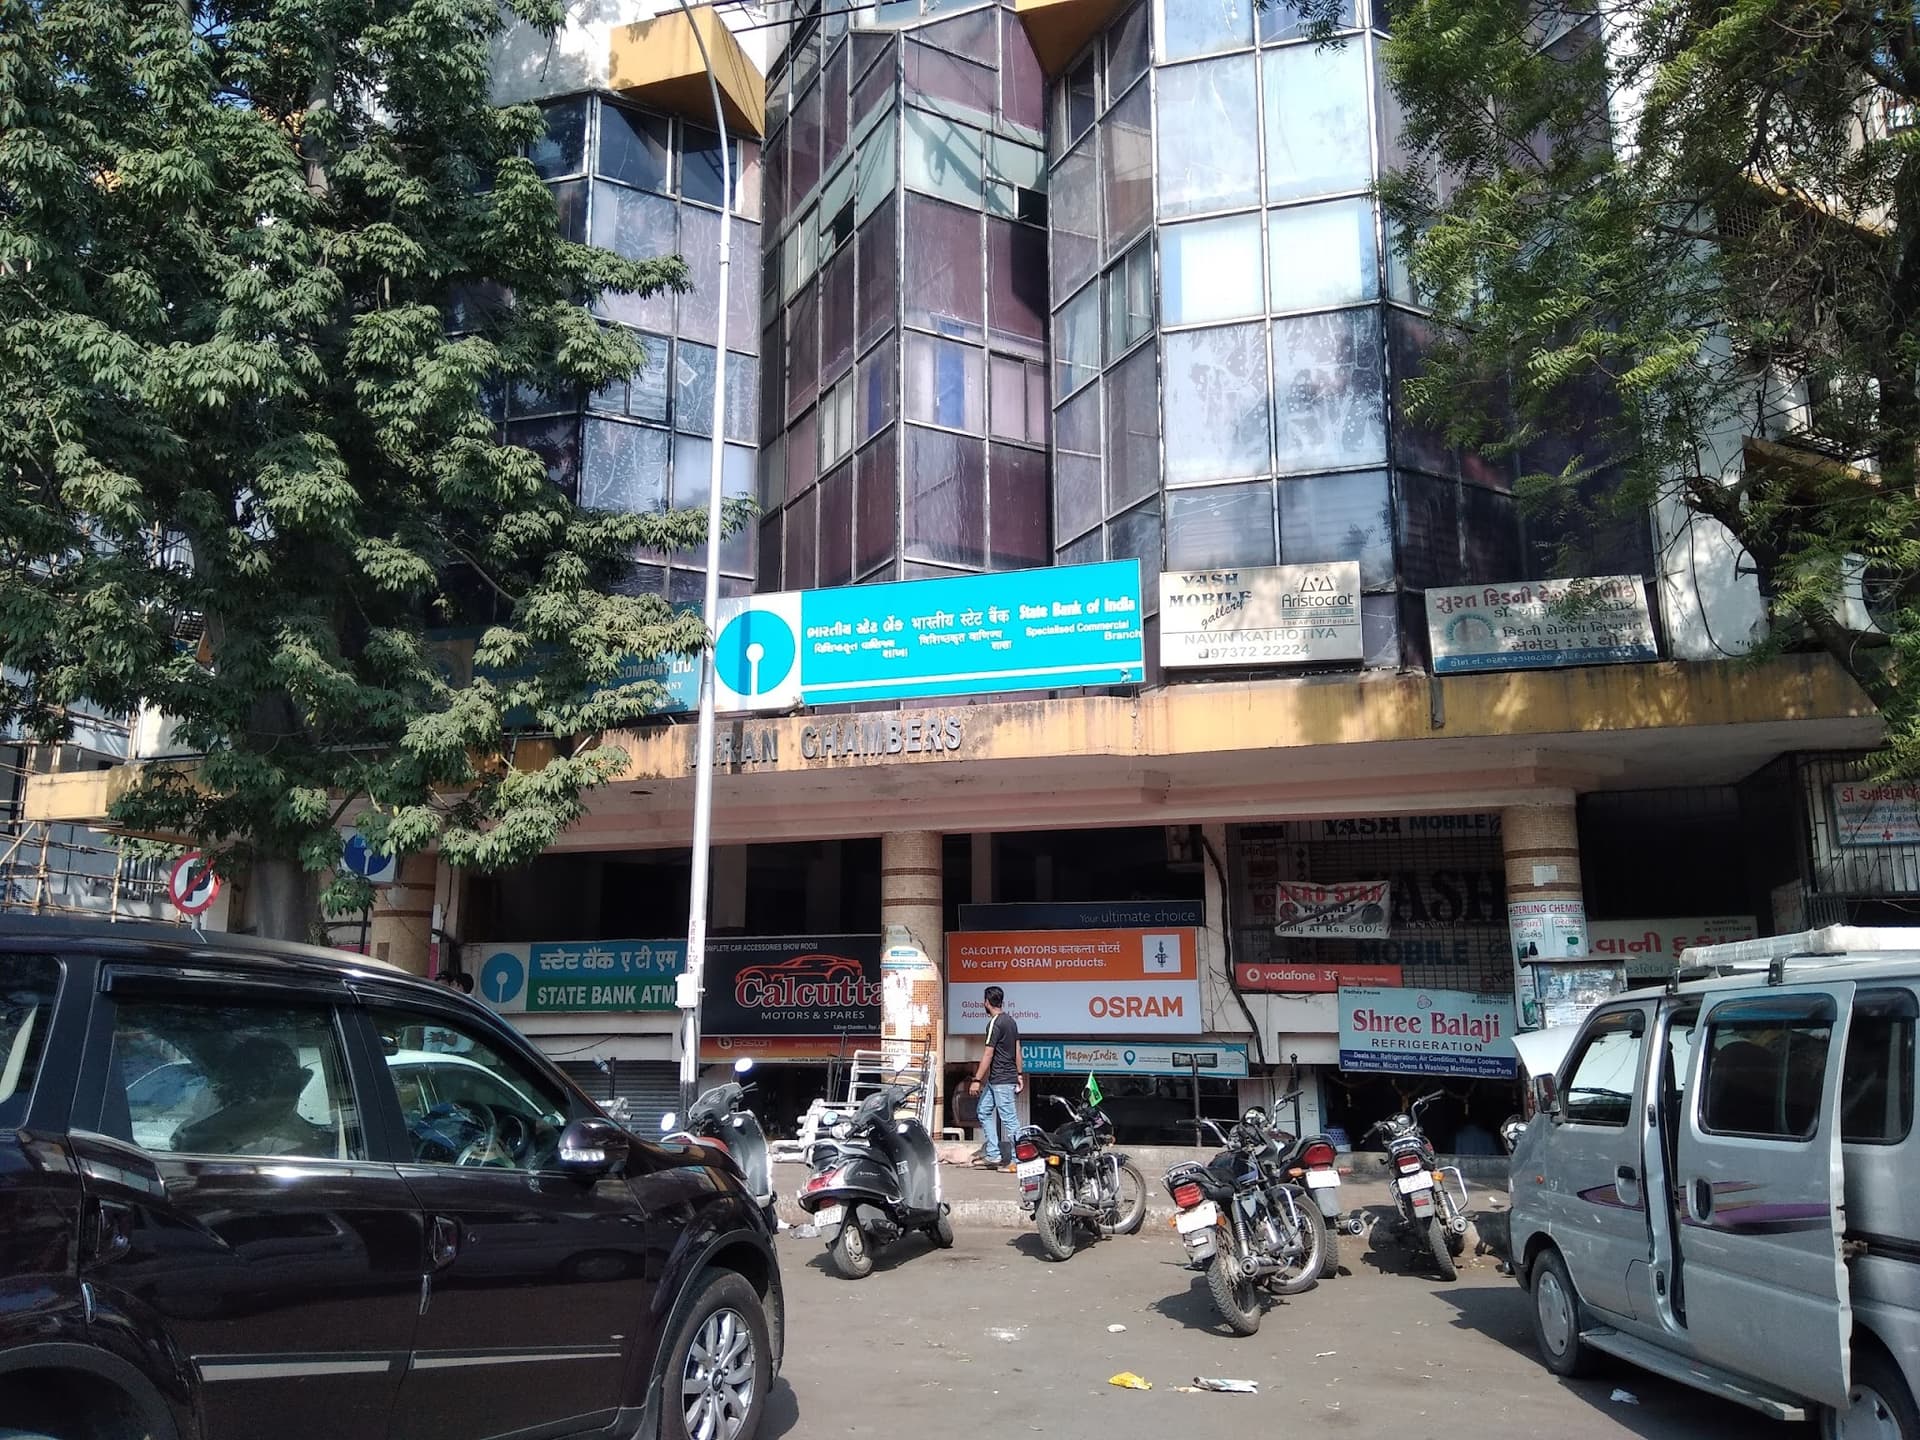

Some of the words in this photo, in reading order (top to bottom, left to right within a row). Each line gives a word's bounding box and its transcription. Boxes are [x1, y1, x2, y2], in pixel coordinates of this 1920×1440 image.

[1168, 590, 1252, 608] MOBILE
[1281, 593, 1354, 608] Aristocrat
[1436, 593, 1477, 614] સુરત
[1484, 586, 1533, 607] કિડની
[1019, 604, 1049, 620] State
[1052, 601, 1083, 617] Bank
[1086, 598, 1100, 614] of
[1104, 596, 1136, 612] India
[1201, 600, 1245, 630] gallery
[911, 609, 955, 631] भारतीय
[960, 606, 983, 627] स्टेट
[988, 604, 1010, 624] बैंक
[1025, 624, 1075, 638] Specialised
[1076, 619, 1130, 633] Commercial
[1103, 629, 1142, 641] Branch
[1185, 631, 1235, 645] NAVIN
[1240, 627, 1337, 642] KATHOTIYA
[1211, 646, 1258, 659] 97372
[1263, 643, 1311, 657] 22224
[672, 659, 695, 674] LTD.
[800, 716, 961, 760] CHAMBERS
[1279, 885, 1327, 901] AERO
[1334, 885, 1383, 901] STAR
[1513, 904, 1547, 914] STERLING
[1549, 903, 1582, 913] CHEMIST
[1079, 913, 1099, 924] Your
[1101, 911, 1151, 923] ultimate
[1154, 910, 1196, 922] choice
[1279, 925, 1304, 935] Only
[1326, 925, 1344, 934] Rs.
[1349, 924, 1384, 934] 500/-
[705, 943, 731, 953] OMPLETE
[743, 942, 783, 952] ACCESSORIES
[783, 941, 800, 951] SHOW
[960, 946, 1012, 956] CALCUTTA
[1014, 945, 1058, 955] MOTORS
[539, 949, 582, 970] स्टेट
[583, 947, 616, 971] बैंक
[620, 951, 631, 972] ए
[635, 945, 652, 969] टी
[655, 950, 679, 972] एम
[962, 959, 978, 969] We
[981, 959, 1008, 970] carry
[1011, 957, 1052, 968] OSRAM
[1055, 957, 1107, 970] products.
[1263, 970, 1316, 981] vodafone
[537, 985, 589, 1005] STATE
[591, 985, 636, 1005] BANK
[641, 984, 676, 1004] ATM
[735, 974, 882, 1008] Calcutta
[961, 1001, 985, 1009] Globa
[1008, 1000, 1016, 1009] in
[1088, 995, 1184, 1018] OSRAM
[761, 1010, 810, 1020] MOTORS
[812, 1010, 821, 1019] &
[824, 1009, 865, 1019] SPARES
[1352, 1008, 1422, 1035] Shree
[1430, 1012, 1501, 1044] Balaji
[1022, 1045, 1062, 1059] CUTTA
[1371, 1037, 1483, 1052] REFRIGERATION
[1034, 1059, 1062, 1069] SPARES
[1353, 1051, 1371, 1059] Deals
[1380, 1053, 1418, 1062] Refrigeration,
[1429, 1055, 1457, 1064] Condition,
[1476, 1057, 1501, 1066] Coolers,
[1399, 1062, 1418, 1070] Ovens
[1424, 1064, 1450, 1073] Washing
[1450, 1065, 1478, 1073] Machines
[1478, 1067, 1495, 1075] Spare
[1496, 1068, 1512, 1076] Parts
